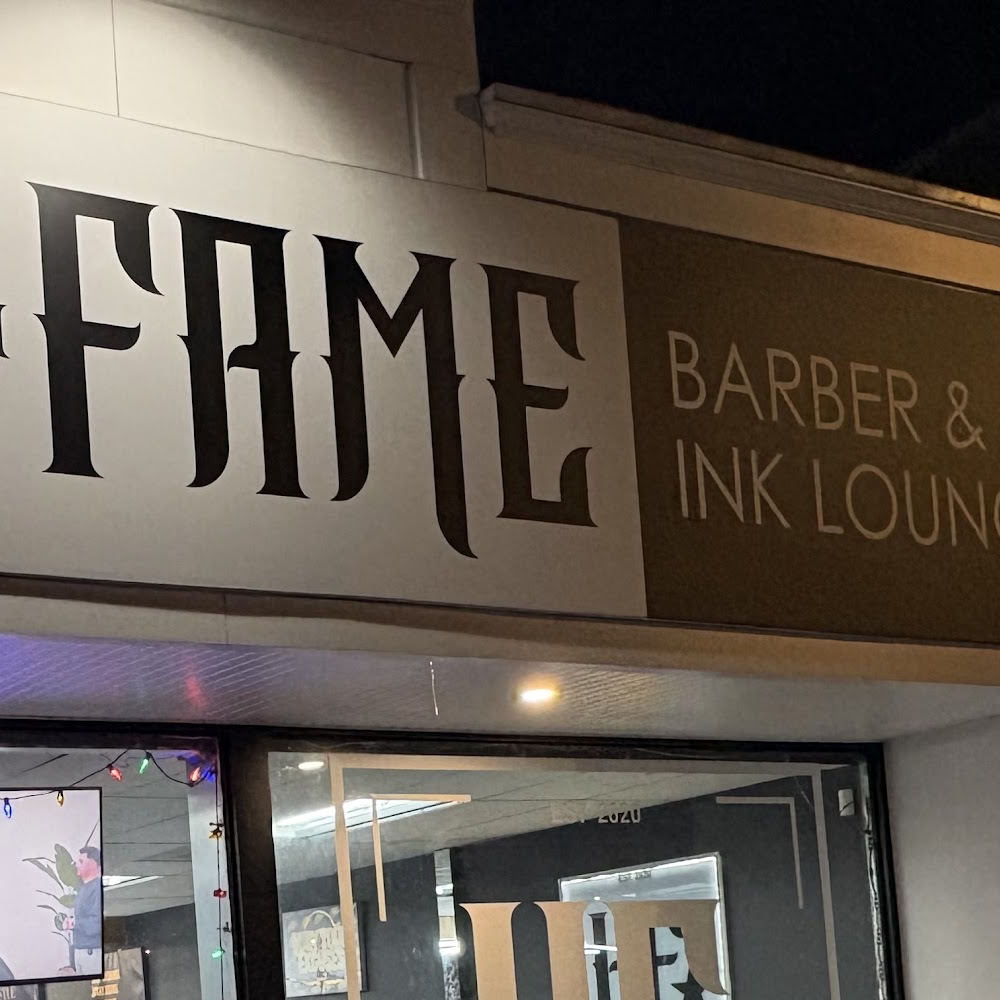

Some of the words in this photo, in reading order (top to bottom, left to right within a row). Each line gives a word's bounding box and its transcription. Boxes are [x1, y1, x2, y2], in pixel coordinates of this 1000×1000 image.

[26, 181, 599, 559] FAME
[667, 330, 921, 443] BARBER
[946, 380, 987, 450] &
[676, 439, 792, 529] INK
[813, 458, 1000, 550] LOUN
